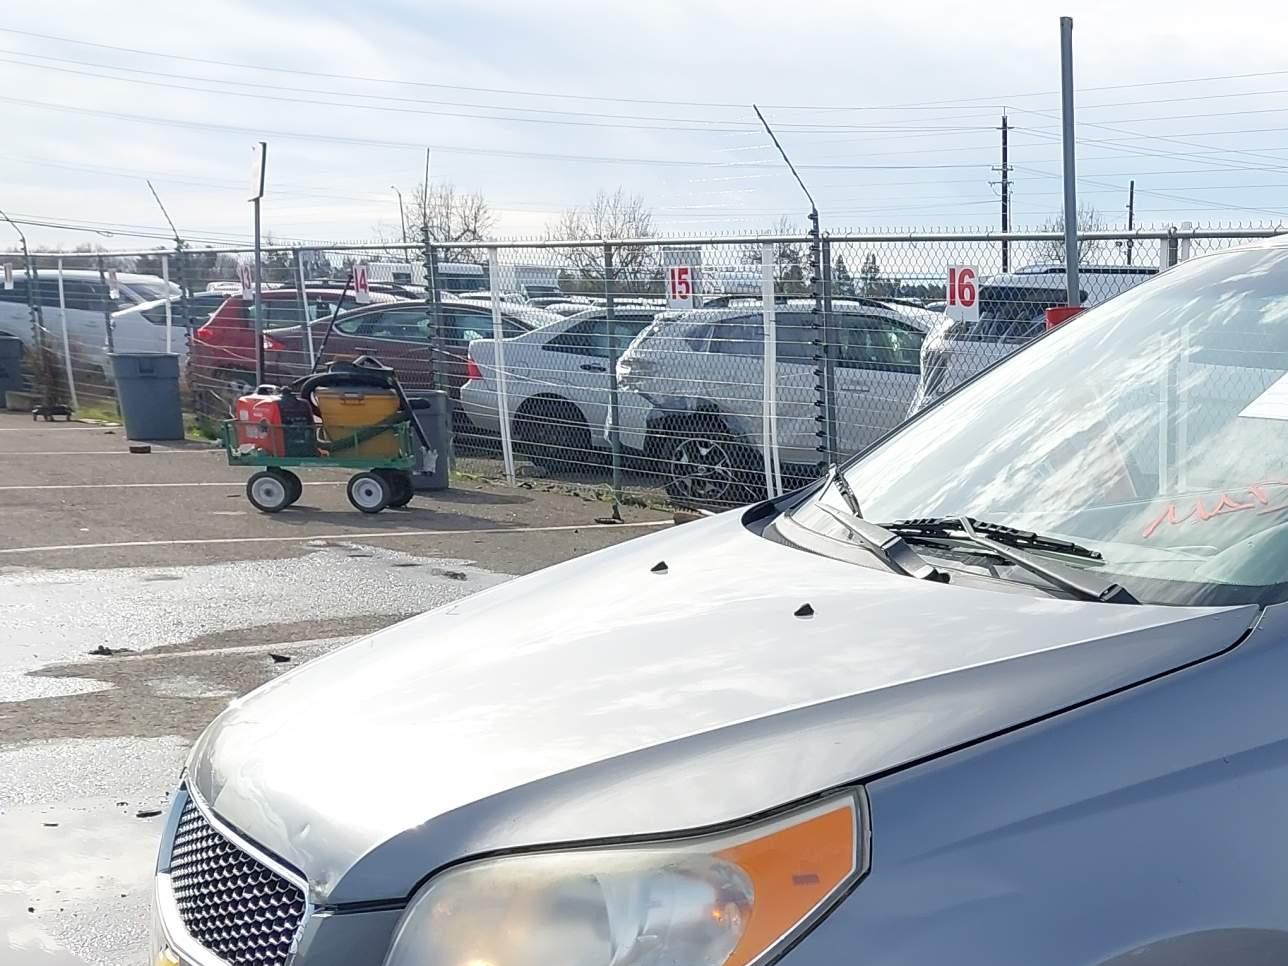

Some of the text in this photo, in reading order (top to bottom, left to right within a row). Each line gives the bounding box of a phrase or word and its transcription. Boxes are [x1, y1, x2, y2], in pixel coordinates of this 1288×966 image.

[354, 267, 368, 293] 14
[670, 267, 690, 300] 15
[949, 267, 976, 308] 16
